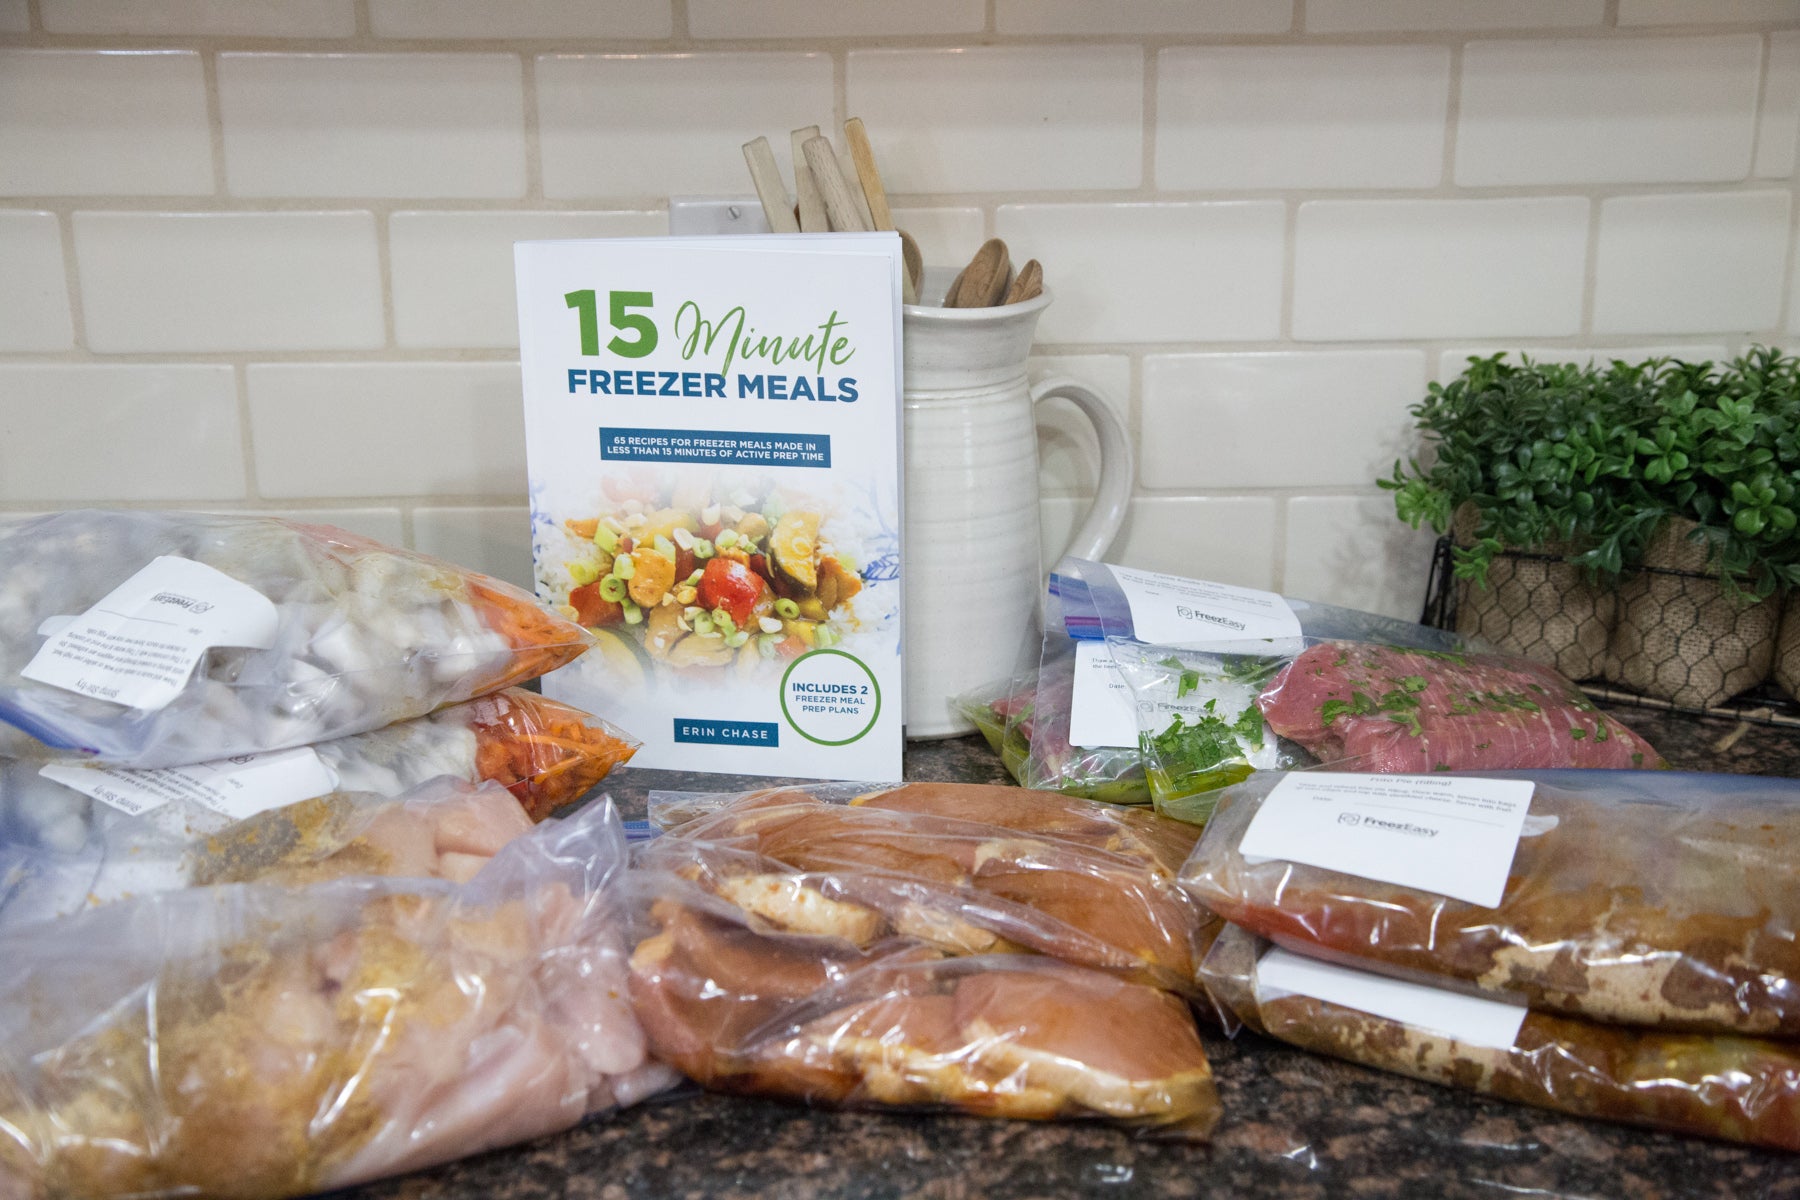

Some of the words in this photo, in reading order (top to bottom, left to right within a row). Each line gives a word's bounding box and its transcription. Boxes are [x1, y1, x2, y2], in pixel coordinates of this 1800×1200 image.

[564, 289, 658, 359] 15
[674, 300, 856, 378] Minute
[567, 368, 727, 399] FREEZER
[737, 374, 859, 403] MEALS
[613, 436, 626, 445] 65
[628, 437, 668, 446] RECIPES
[671, 438, 691, 447] FOR
[693, 439, 737, 449] FREEZER
[739, 440, 772, 450] MEALS
[774, 442, 803, 451] MADE
[806, 443, 816, 451] IN
[607, 446, 630, 455] LESS
[633, 446, 660, 456] THAN
[662, 448, 672, 456] 15
[674, 448, 717, 458] MINUTES
[719, 449, 733, 458] OF
[735, 450, 771, 460] ACTIVE
[773, 452, 798, 460] PREP
[801, 453, 824, 461] TIME
[1194, 610, 1246, 631] FreezEasy
[792, 682, 857, 694] INCLUDES
[860, 686, 869, 695] 2
[795, 694, 837, 704] FREEZER
[840, 697, 866, 705] MEAL
[802, 705, 826, 713] PREP
[828, 706, 859, 715] PLANS
[682, 726, 715, 737] ERIN
[722, 728, 768, 740] CHASE
[1364, 816, 1439, 837] FreezEasy
